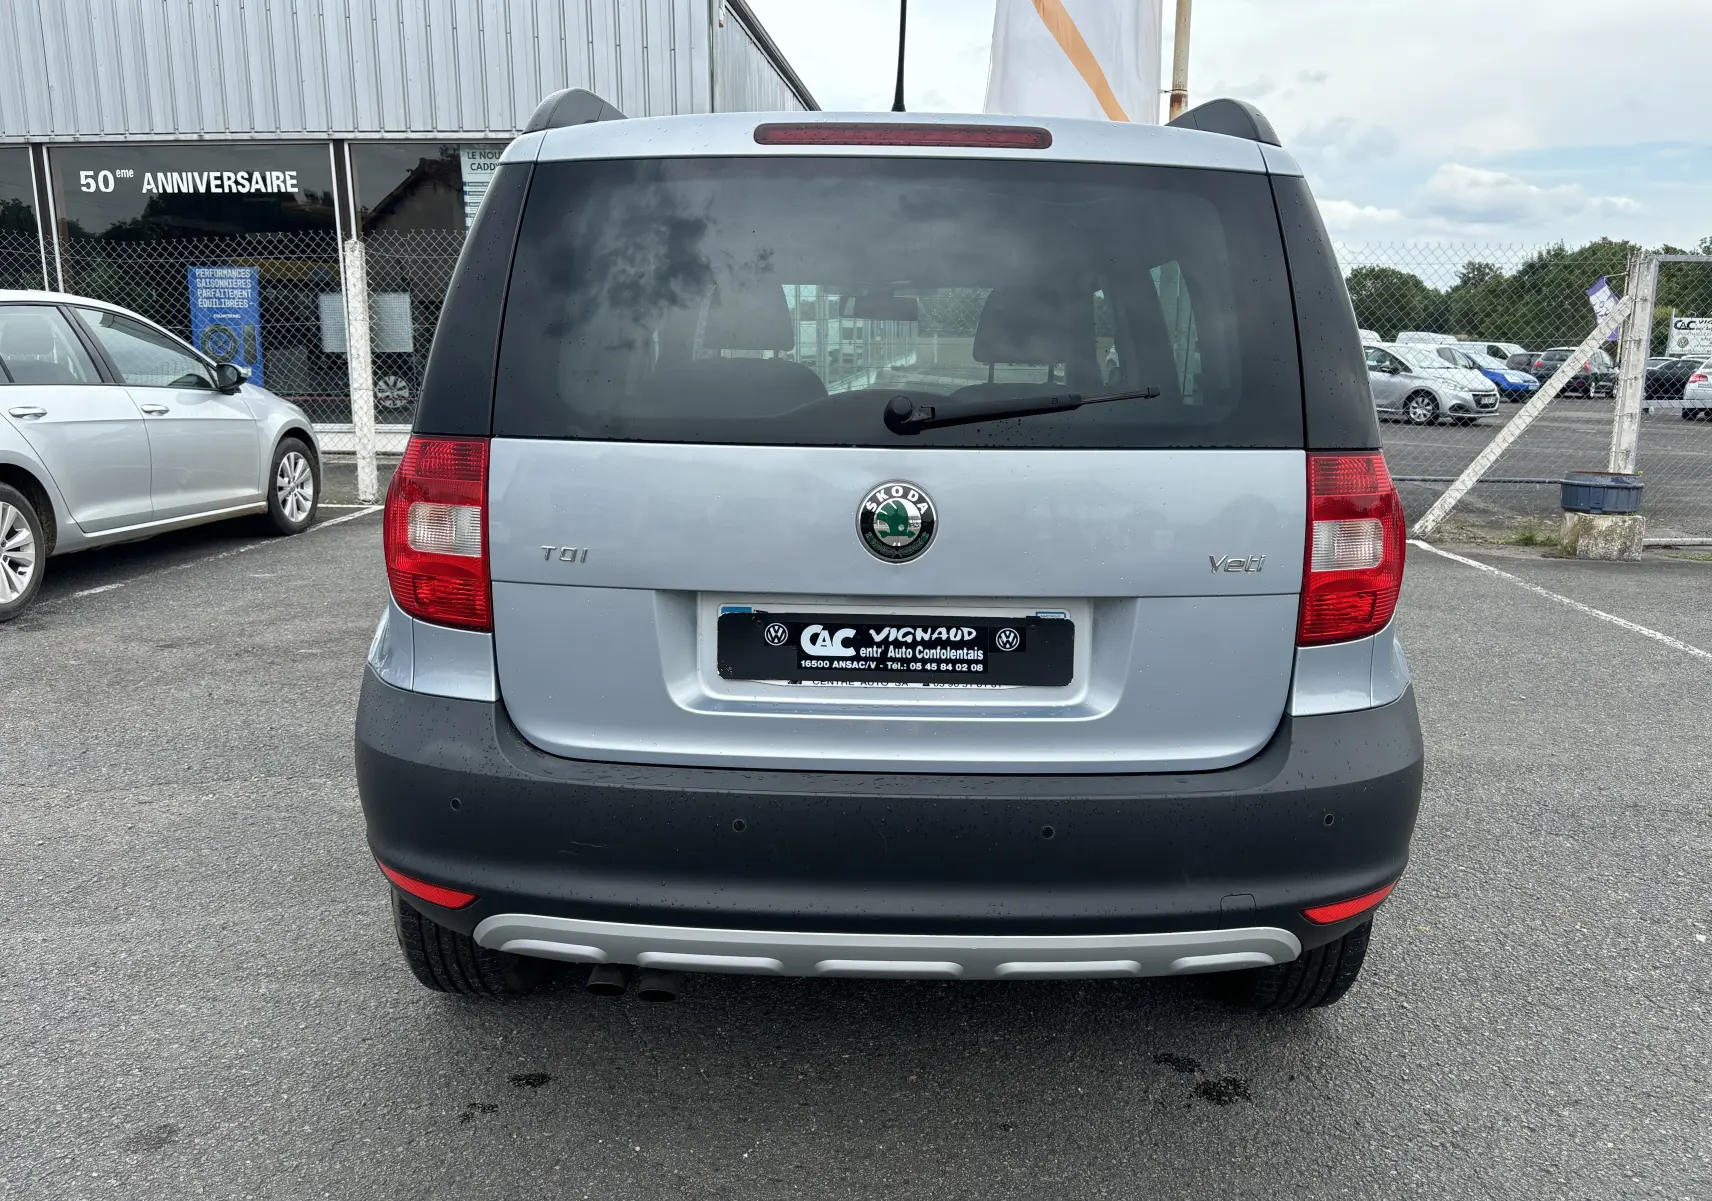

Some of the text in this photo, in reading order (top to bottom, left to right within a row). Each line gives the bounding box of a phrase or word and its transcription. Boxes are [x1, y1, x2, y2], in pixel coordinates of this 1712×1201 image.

[467, 151, 504, 160] LE NOU
[142, 170, 299, 194] ANNIVERSAIRE
[195, 268, 251, 278] PERFORMANCES
[197, 288, 252, 298] PARFAITEMENT
[1674, 320, 1697, 330] CAC
[540, 545, 589, 564] TDI
[1209, 554, 1267, 574] Yeti
[800, 624, 977, 657] CAC VIGNAUD
[887, 645, 913, 659] Auto
[915, 645, 984, 661] Confolentais
[800, 660, 830, 668] 16500
[832, 660, 877, 669] ANSAC/V
[909, 662, 922, 670] 05
[924, 662, 938, 671] 45
[940, 663, 953, 671] 84
[955, 664, 969, 672] 02
[970, 664, 984, 672] 08
